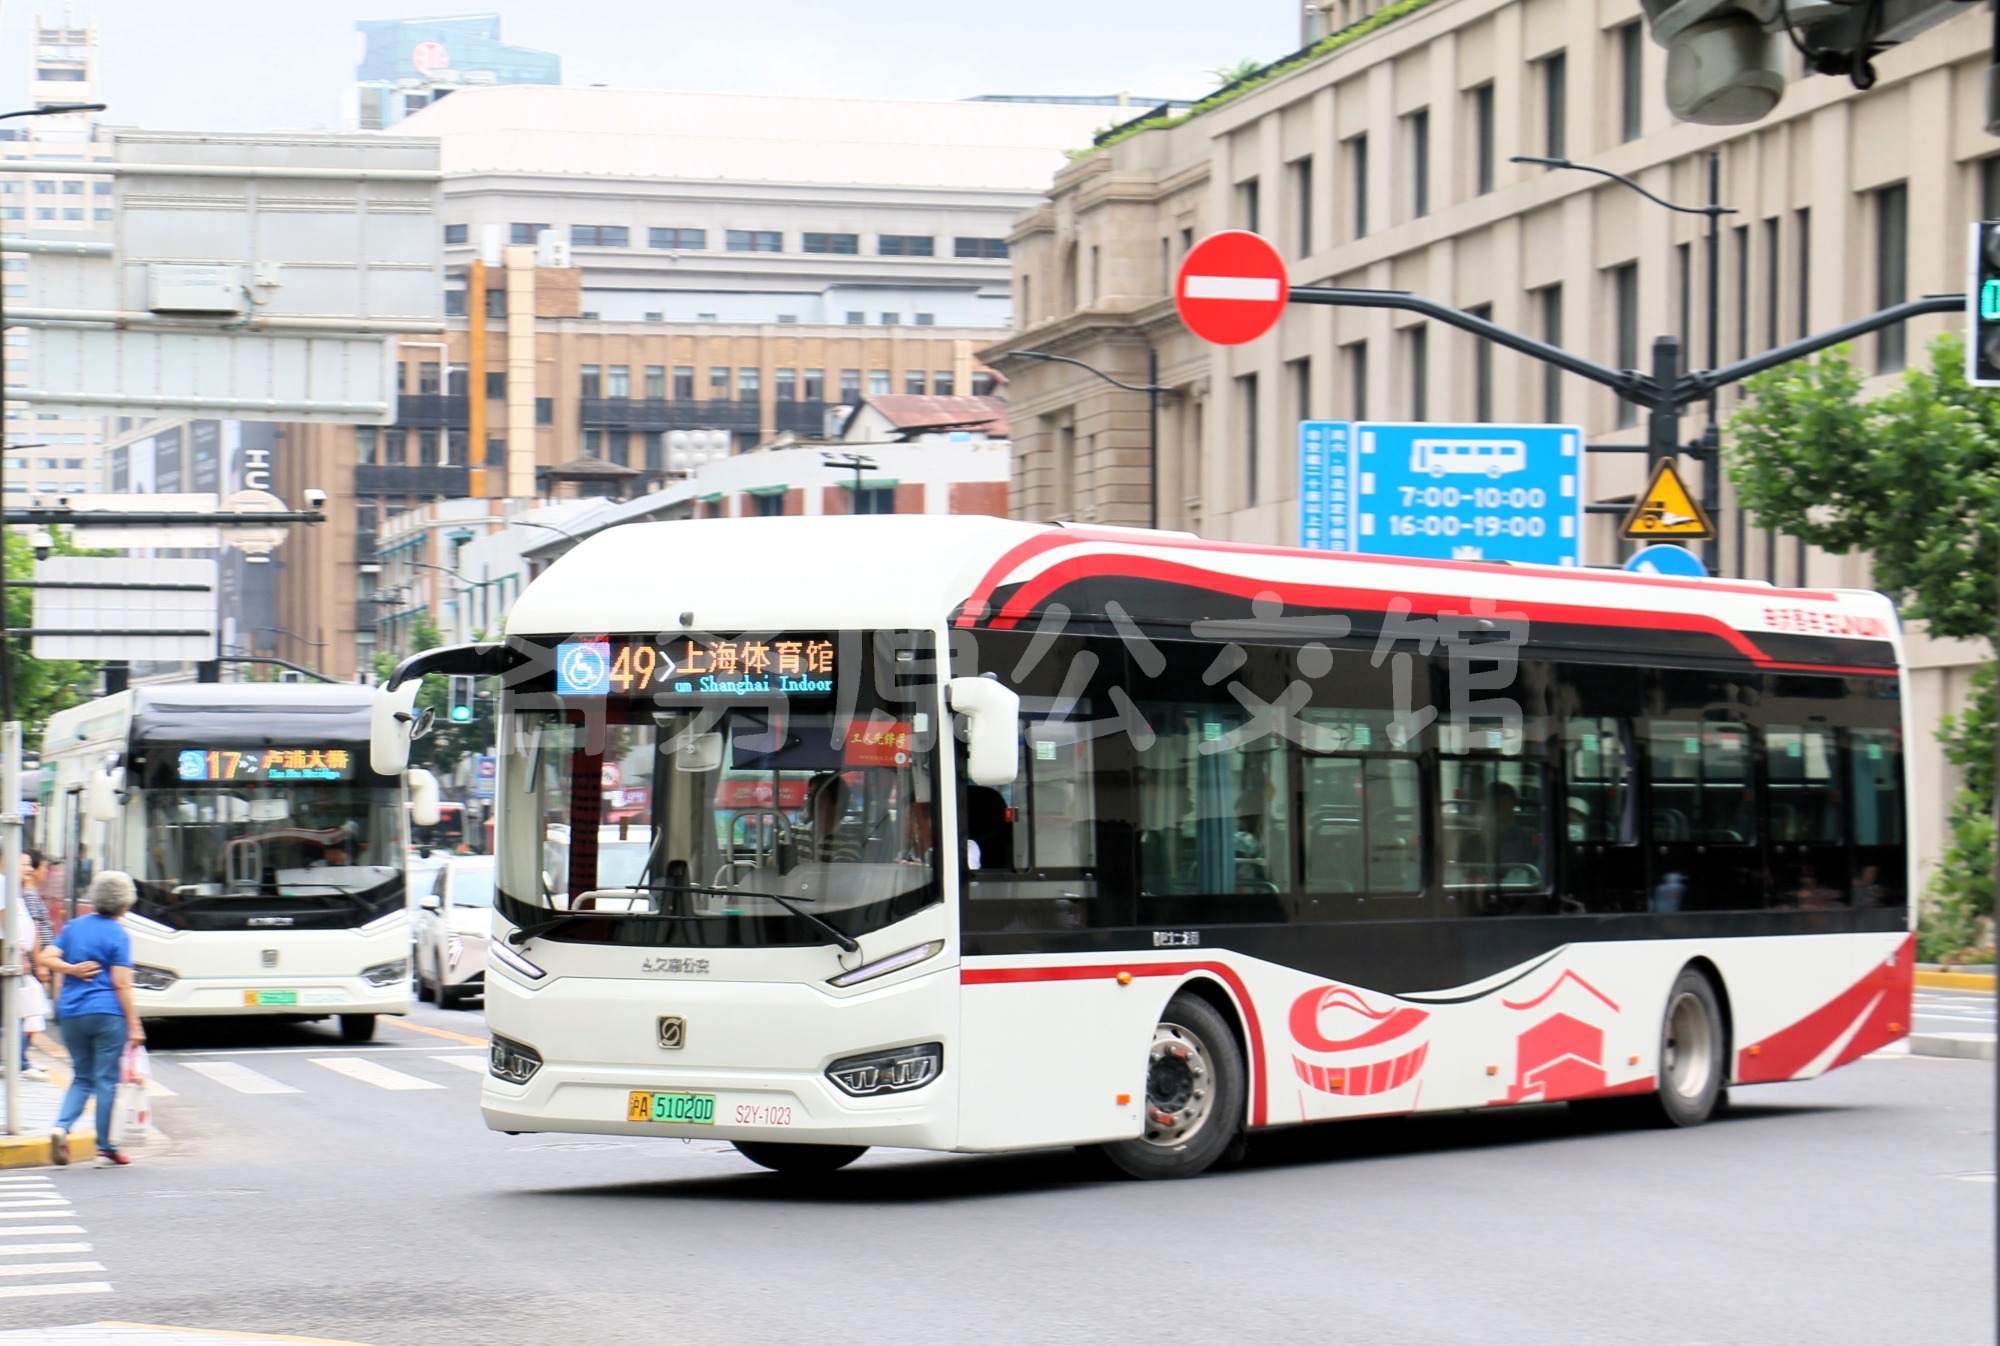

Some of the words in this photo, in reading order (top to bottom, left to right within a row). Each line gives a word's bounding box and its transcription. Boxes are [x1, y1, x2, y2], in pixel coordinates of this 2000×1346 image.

[1398, 486, 1547, 508] 7:00-10:00
[1389, 515, 1547, 537] 16:00-19:00
[609, 646, 656, 690] 49
[676, 640, 834, 675] 上海体育馆
[699, 675, 770, 695] Shanghai
[779, 676, 833, 692] Indoor
[206, 751, 242, 779] 17
[735, 1104, 792, 1126] S2Y-1023
